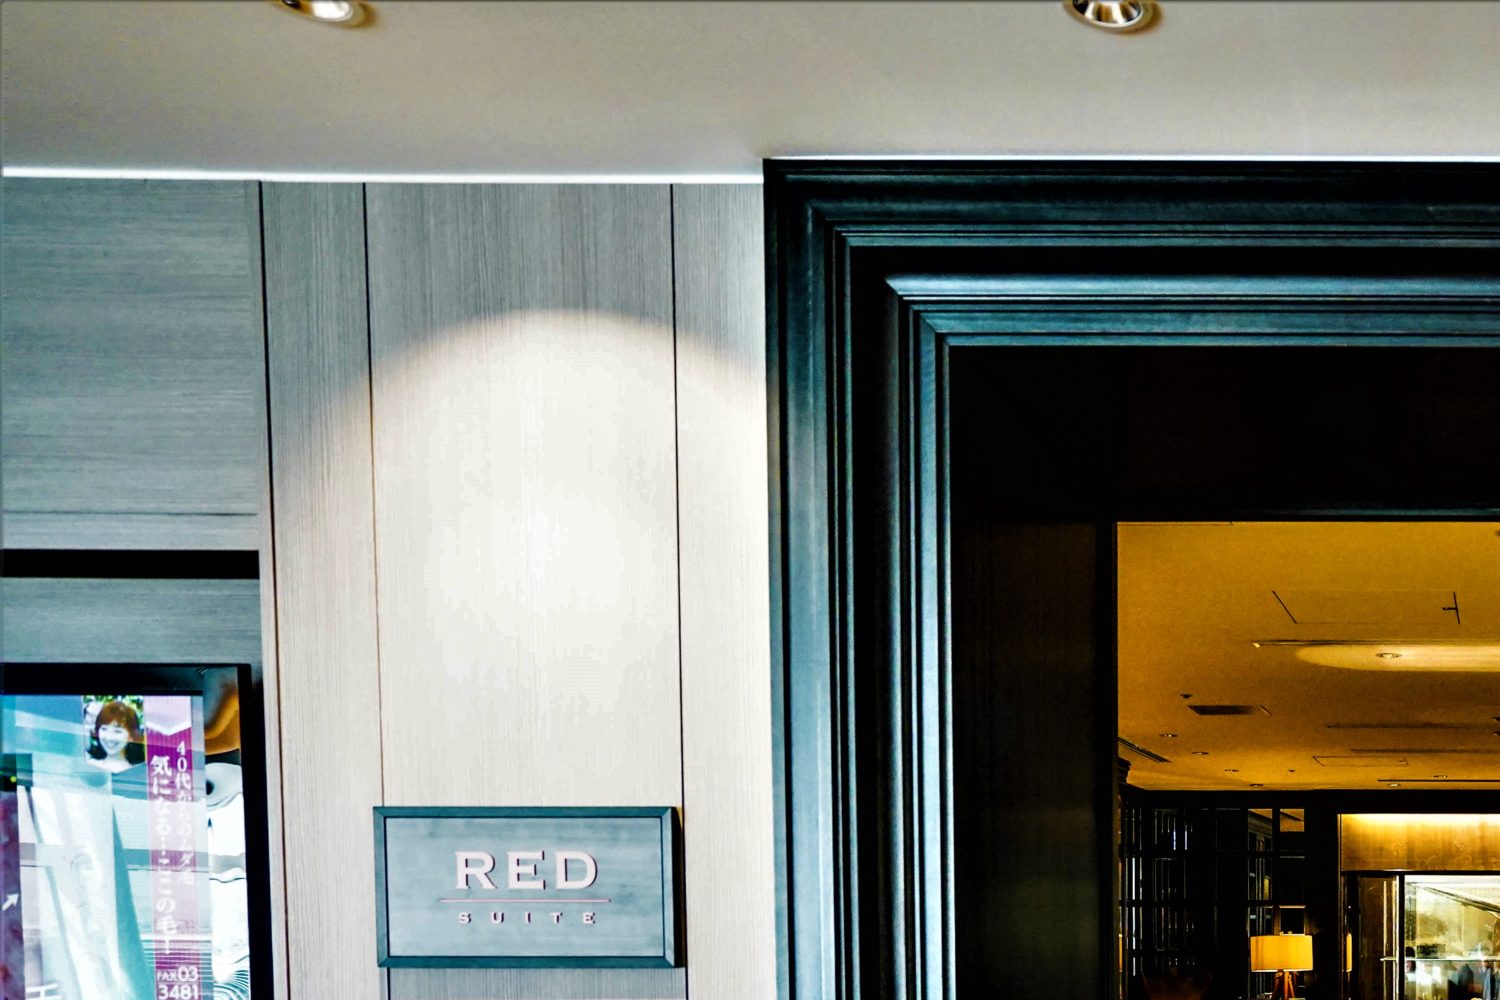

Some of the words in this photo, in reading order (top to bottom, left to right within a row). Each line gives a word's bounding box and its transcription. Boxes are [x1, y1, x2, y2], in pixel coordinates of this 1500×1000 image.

[455, 850, 598, 890] RED
[458, 911, 596, 924] SUITE
[178, 966, 198, 982] 03
[158, 984, 198, 1000] 3481
